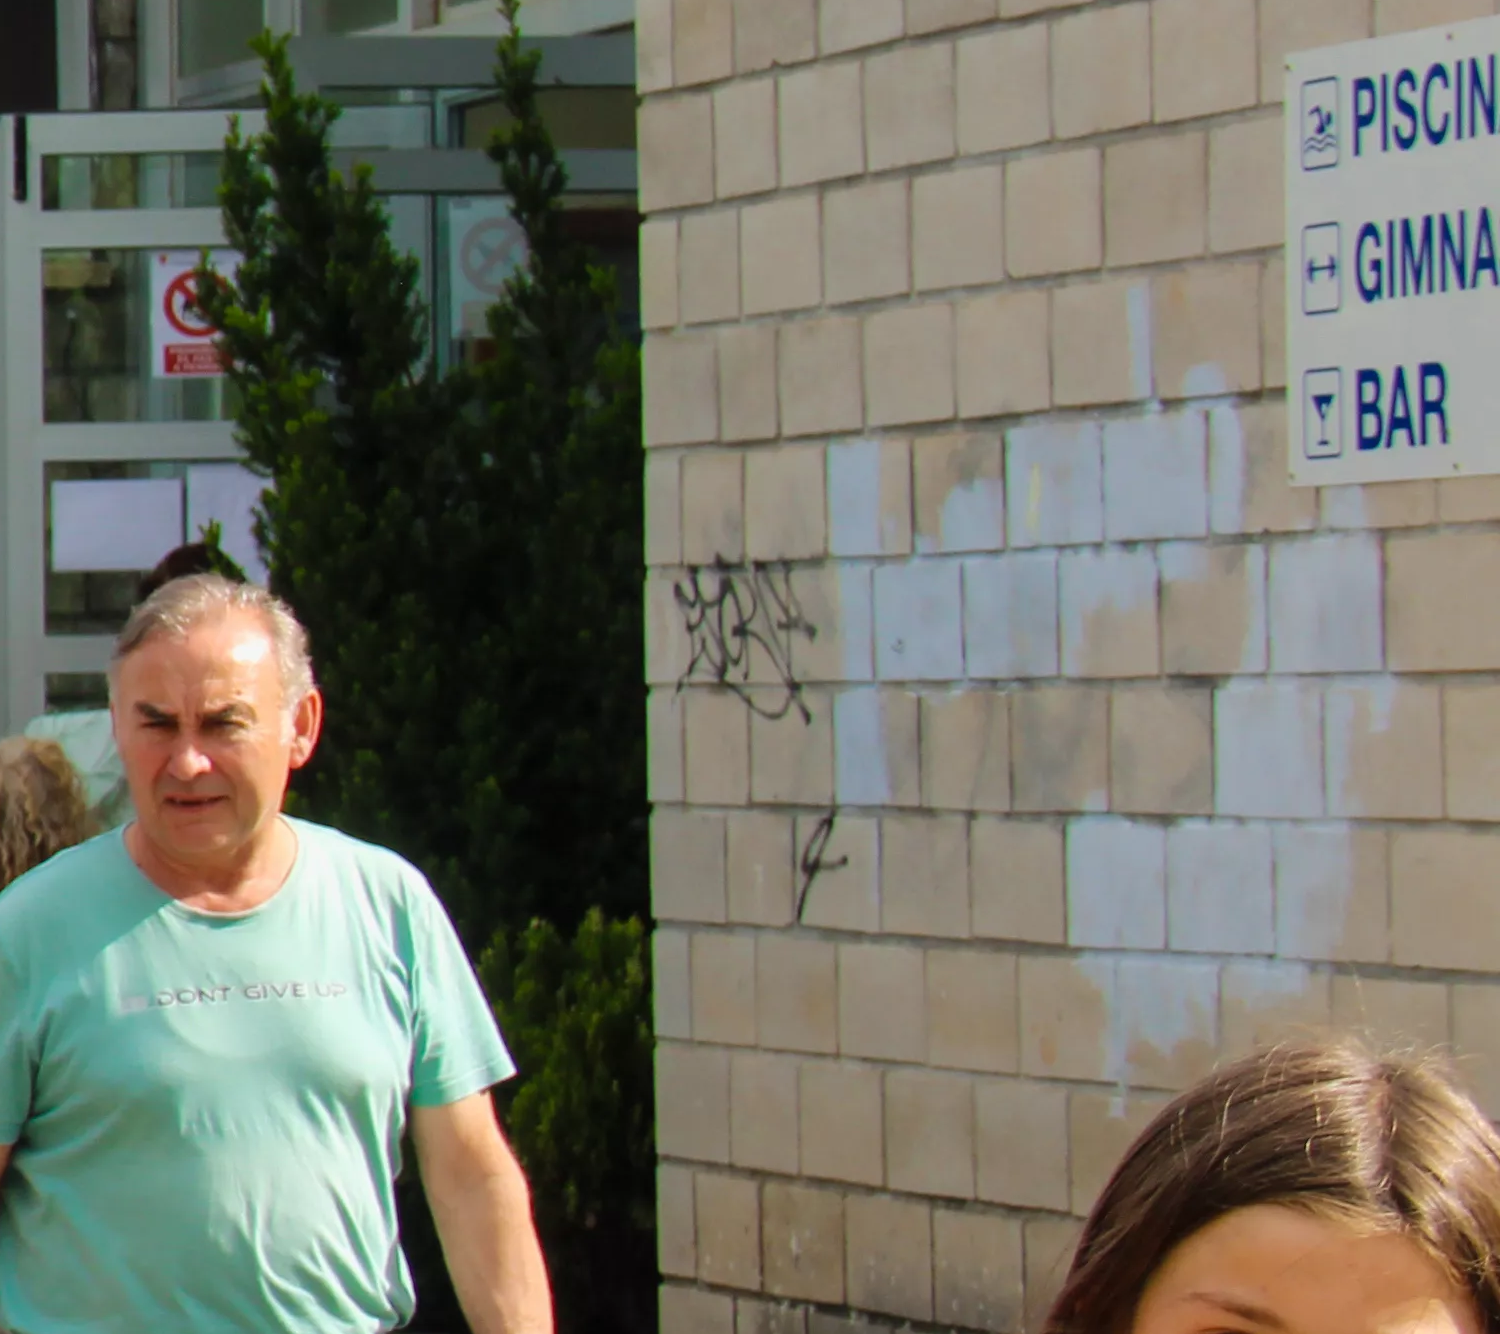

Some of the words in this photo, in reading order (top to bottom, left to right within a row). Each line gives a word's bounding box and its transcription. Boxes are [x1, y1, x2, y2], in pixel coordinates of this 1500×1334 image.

[1352, 53, 1500, 158] PISCIN
[1354, 361, 1450, 451] BAR
[157, 986, 230, 1007] DONT
[243, 982, 306, 1001] GIVE
[314, 980, 348, 998] UP
